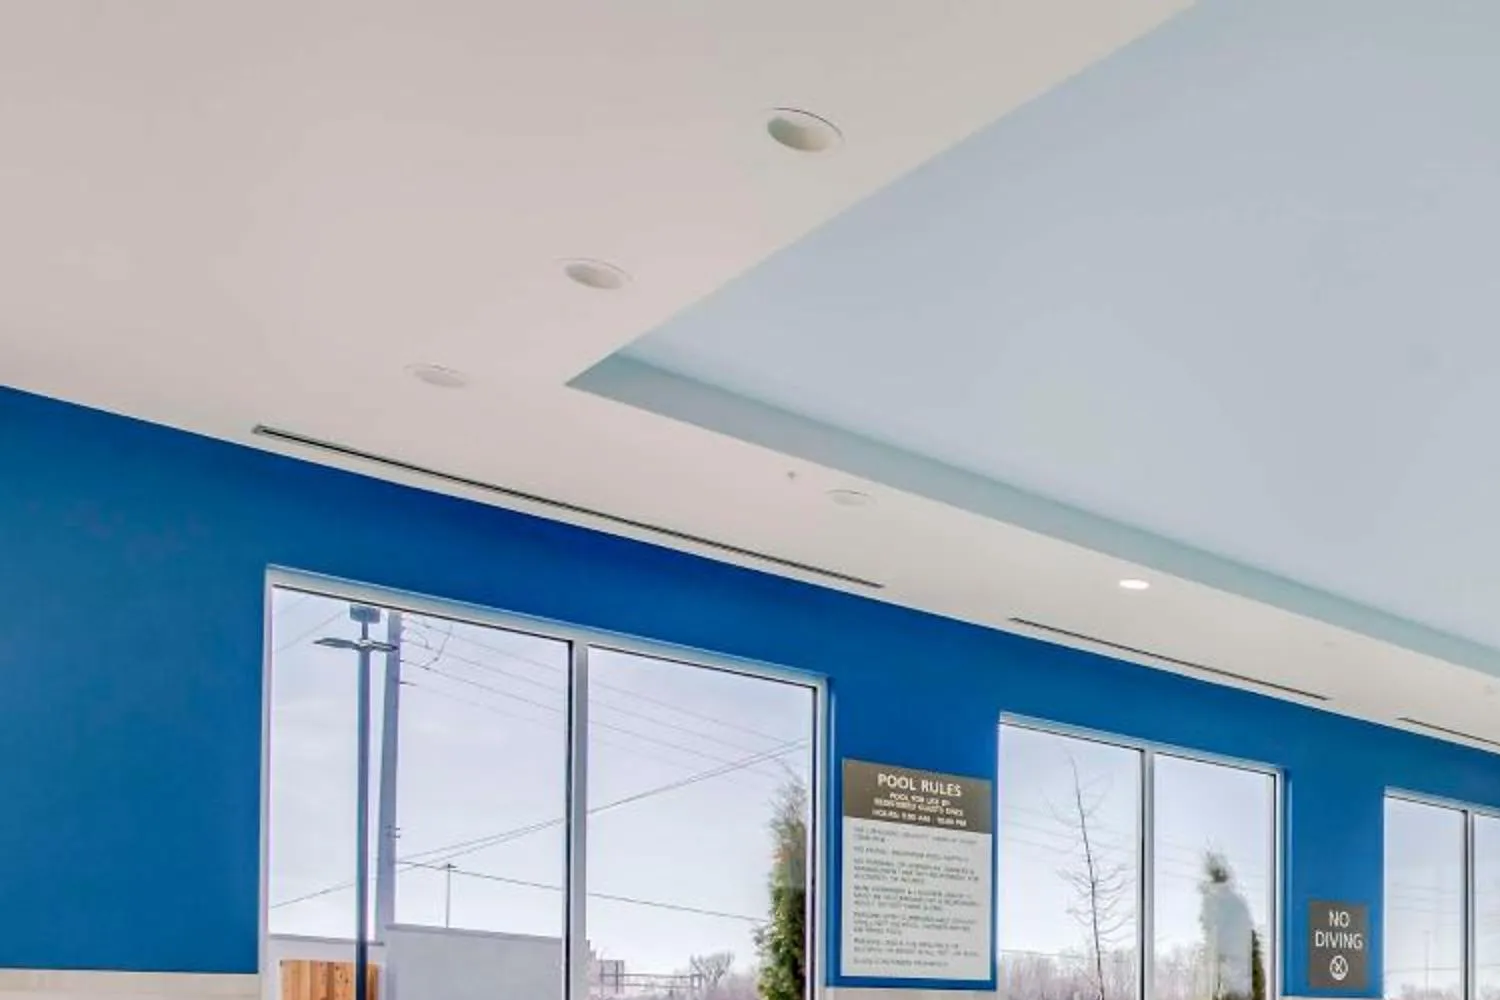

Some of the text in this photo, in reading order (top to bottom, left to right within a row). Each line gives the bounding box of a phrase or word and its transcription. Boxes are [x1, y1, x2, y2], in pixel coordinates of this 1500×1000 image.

[877, 773, 962, 797] POOL RULES
[1329, 910, 1350, 928] NO
[1315, 931, 1363, 949] DIVING
